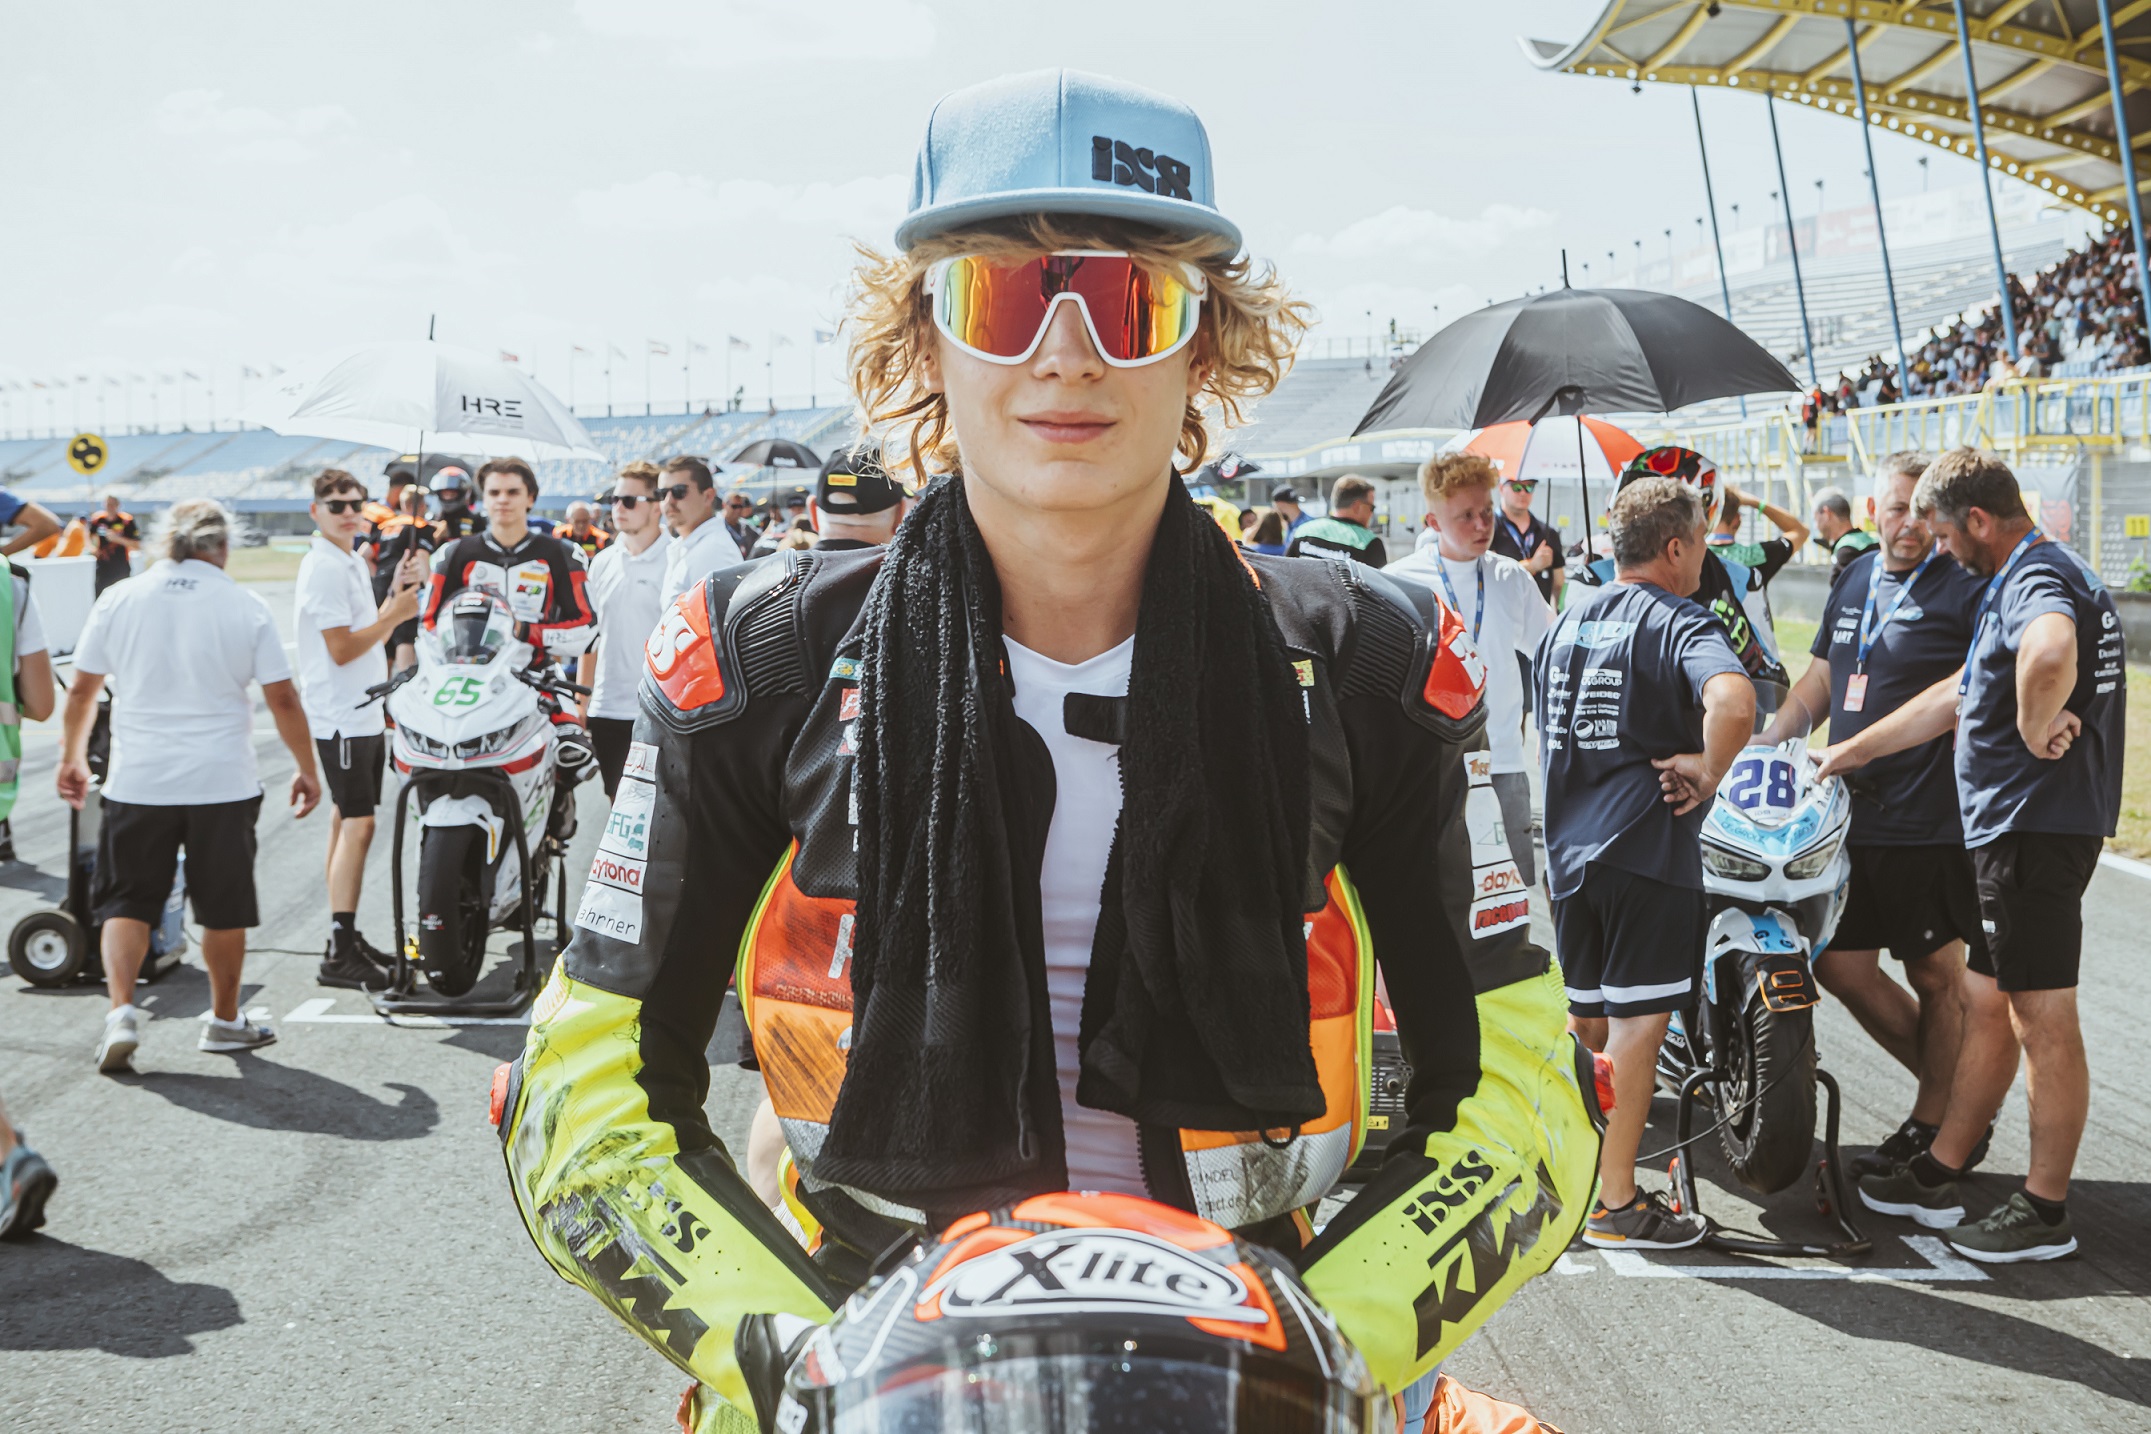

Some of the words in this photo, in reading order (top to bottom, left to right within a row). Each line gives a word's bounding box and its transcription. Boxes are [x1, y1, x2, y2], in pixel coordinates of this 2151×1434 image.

[462, 395, 523, 418] HRE
[433, 676, 485, 706] 65
[1728, 758, 1796, 811] 28
